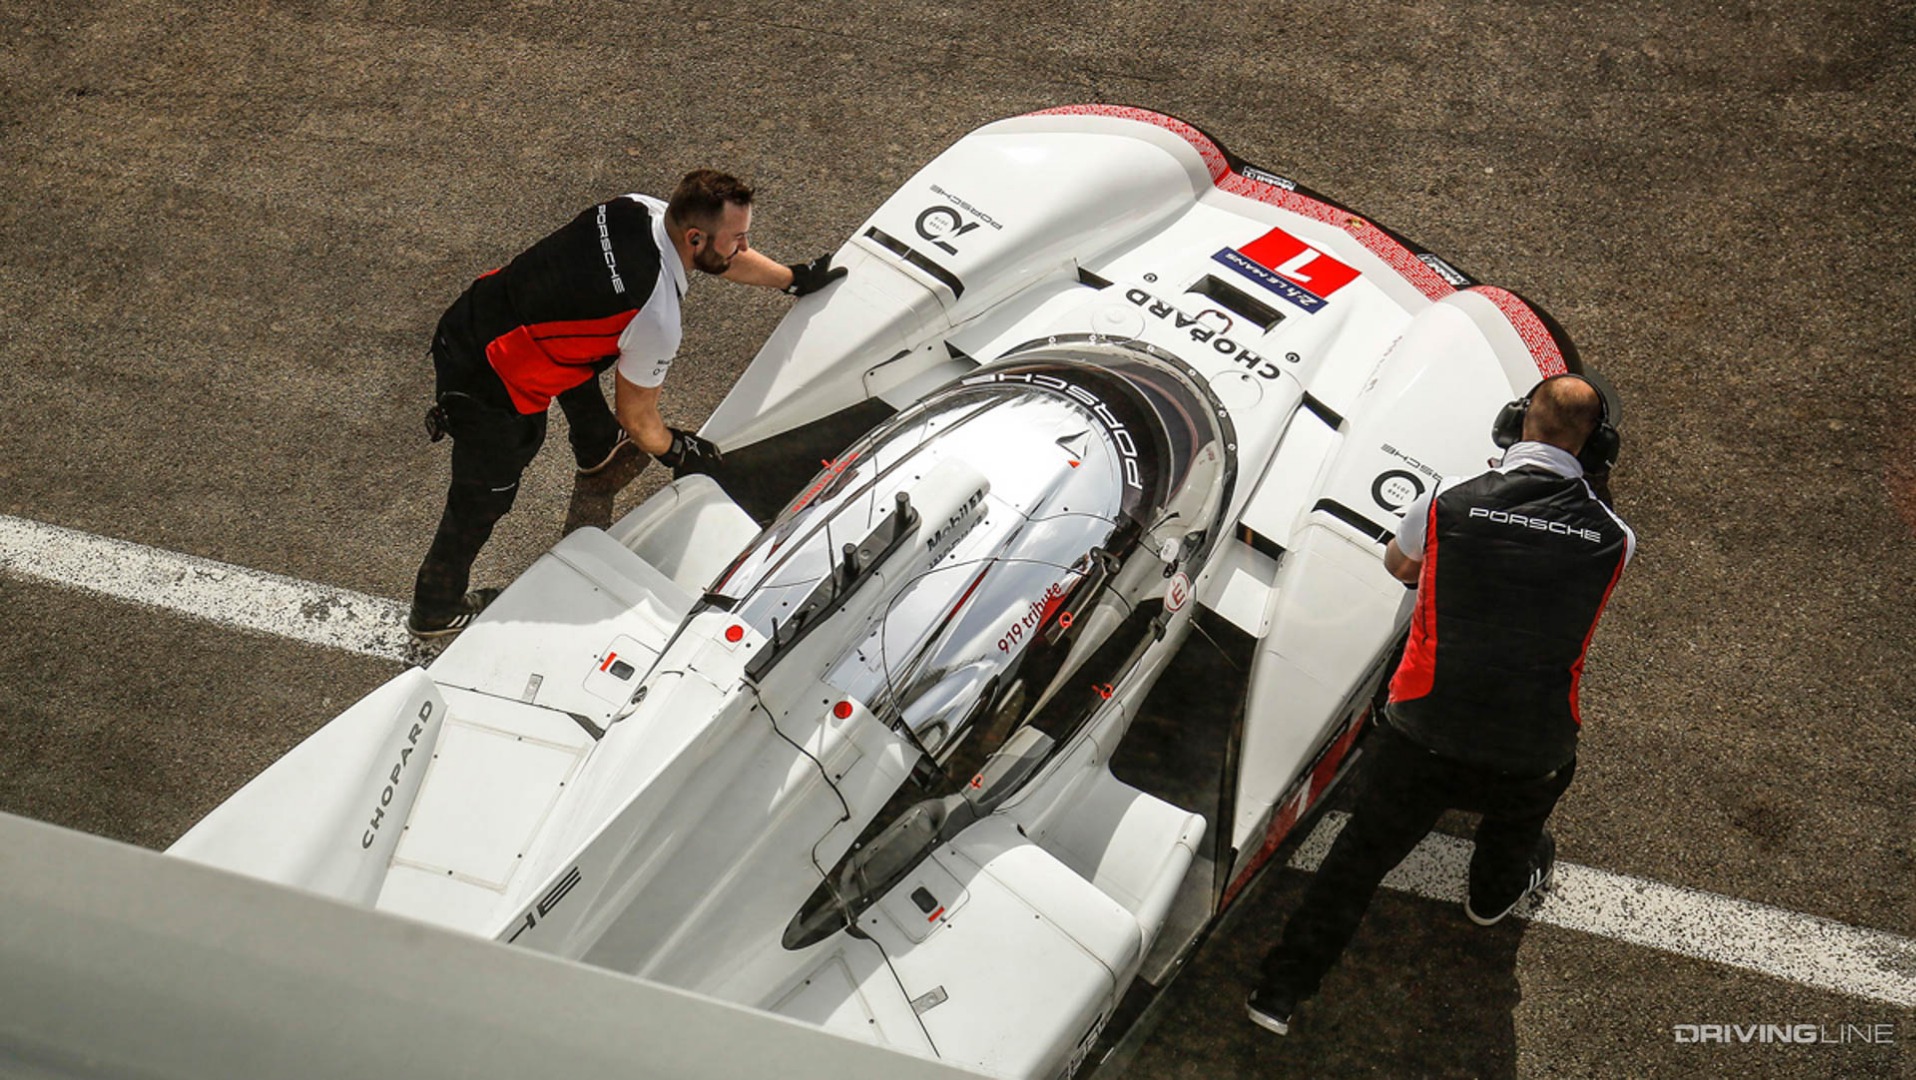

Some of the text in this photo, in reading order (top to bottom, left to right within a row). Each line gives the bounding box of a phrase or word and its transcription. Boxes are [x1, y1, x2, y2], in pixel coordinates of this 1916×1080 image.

[915, 205, 980, 256] 70
[929, 184, 1003, 231] PORSCHE
[597, 203, 625, 294] PORSCHE
[1225, 252, 1268, 279] MANS
[1274, 248, 1321, 283] 1
[1266, 277, 1288, 289] LE
[1125, 288, 1281, 380] CHOPARD
[1381, 443, 1442, 481] RSCHE
[1469, 507, 1601, 543] PORSCHE
[997, 581, 1063, 654] 919 tribute
[362, 700, 433, 850] CHOPARD
